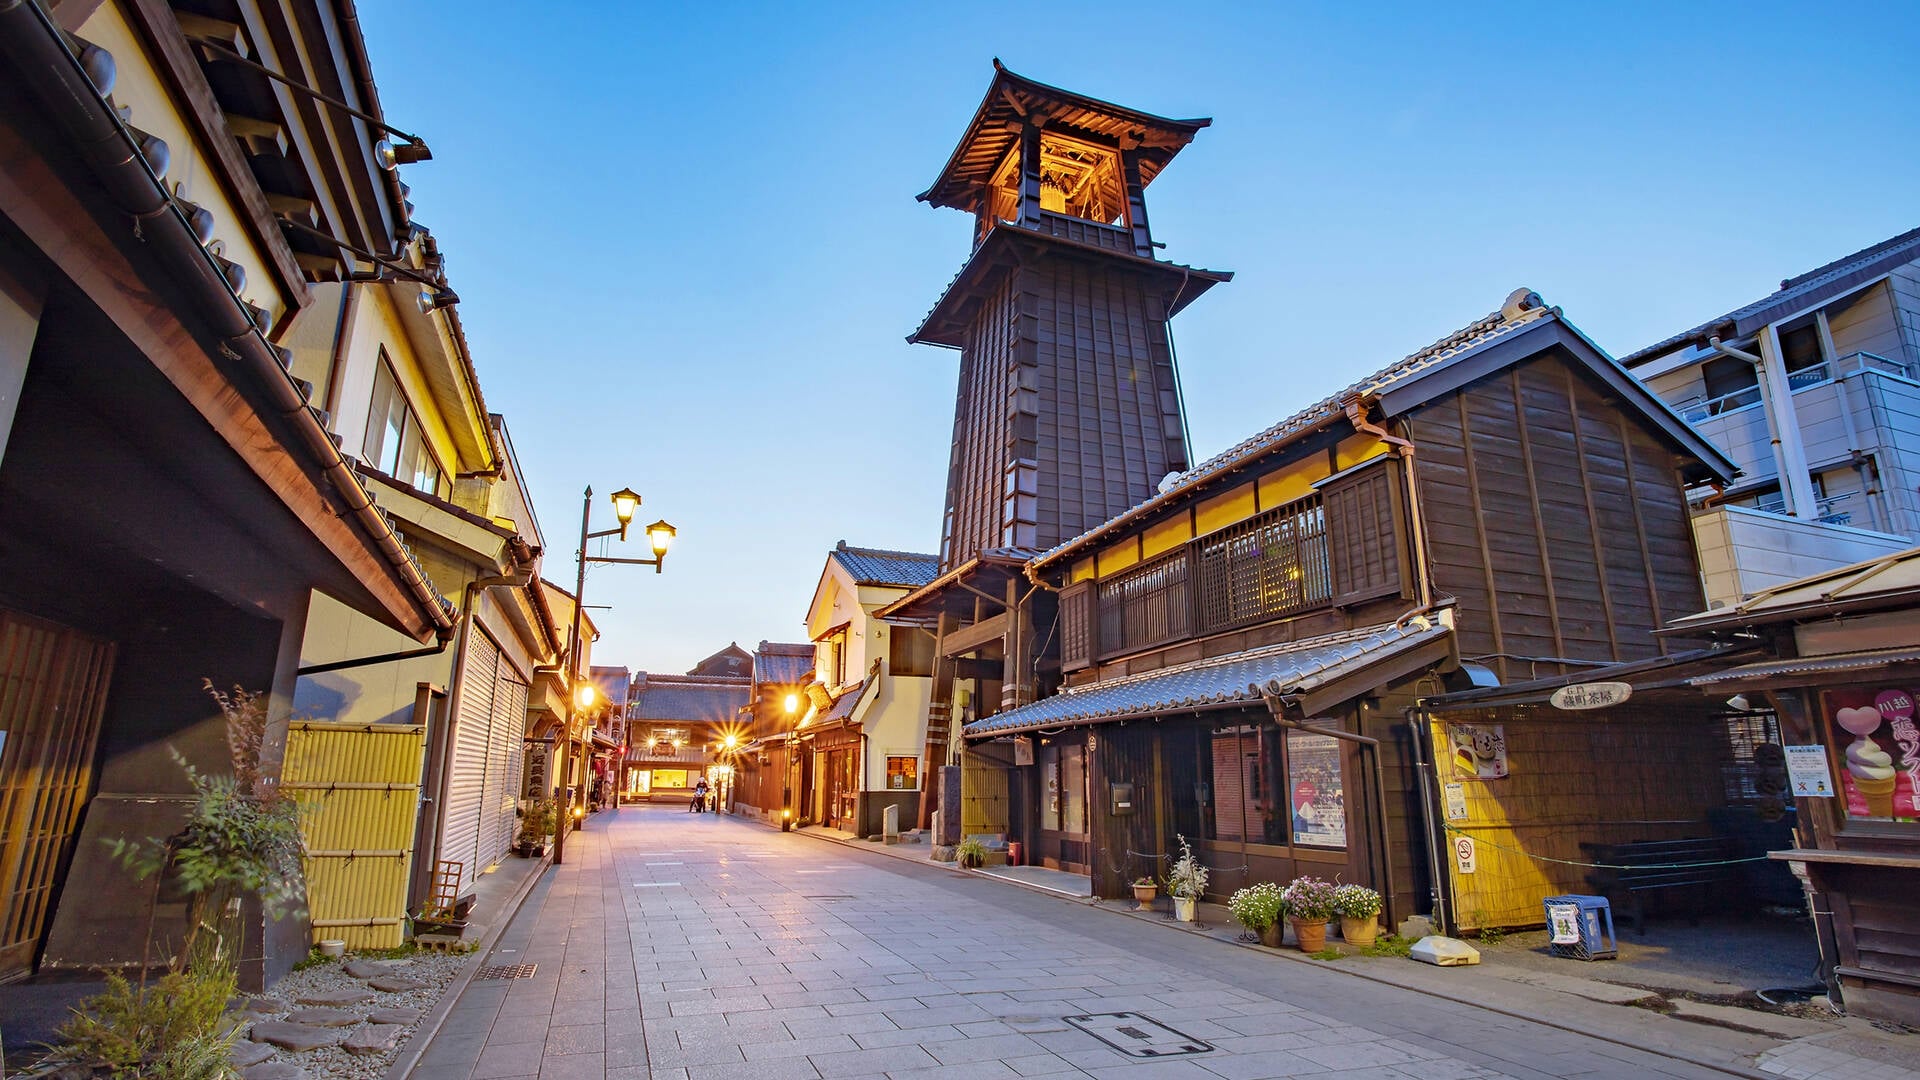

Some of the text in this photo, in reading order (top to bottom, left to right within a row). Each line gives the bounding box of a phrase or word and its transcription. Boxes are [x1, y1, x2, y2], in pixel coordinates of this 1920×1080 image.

[1878, 696, 1910, 713] 川越
[1472, 734, 1505, 752] いも恋
